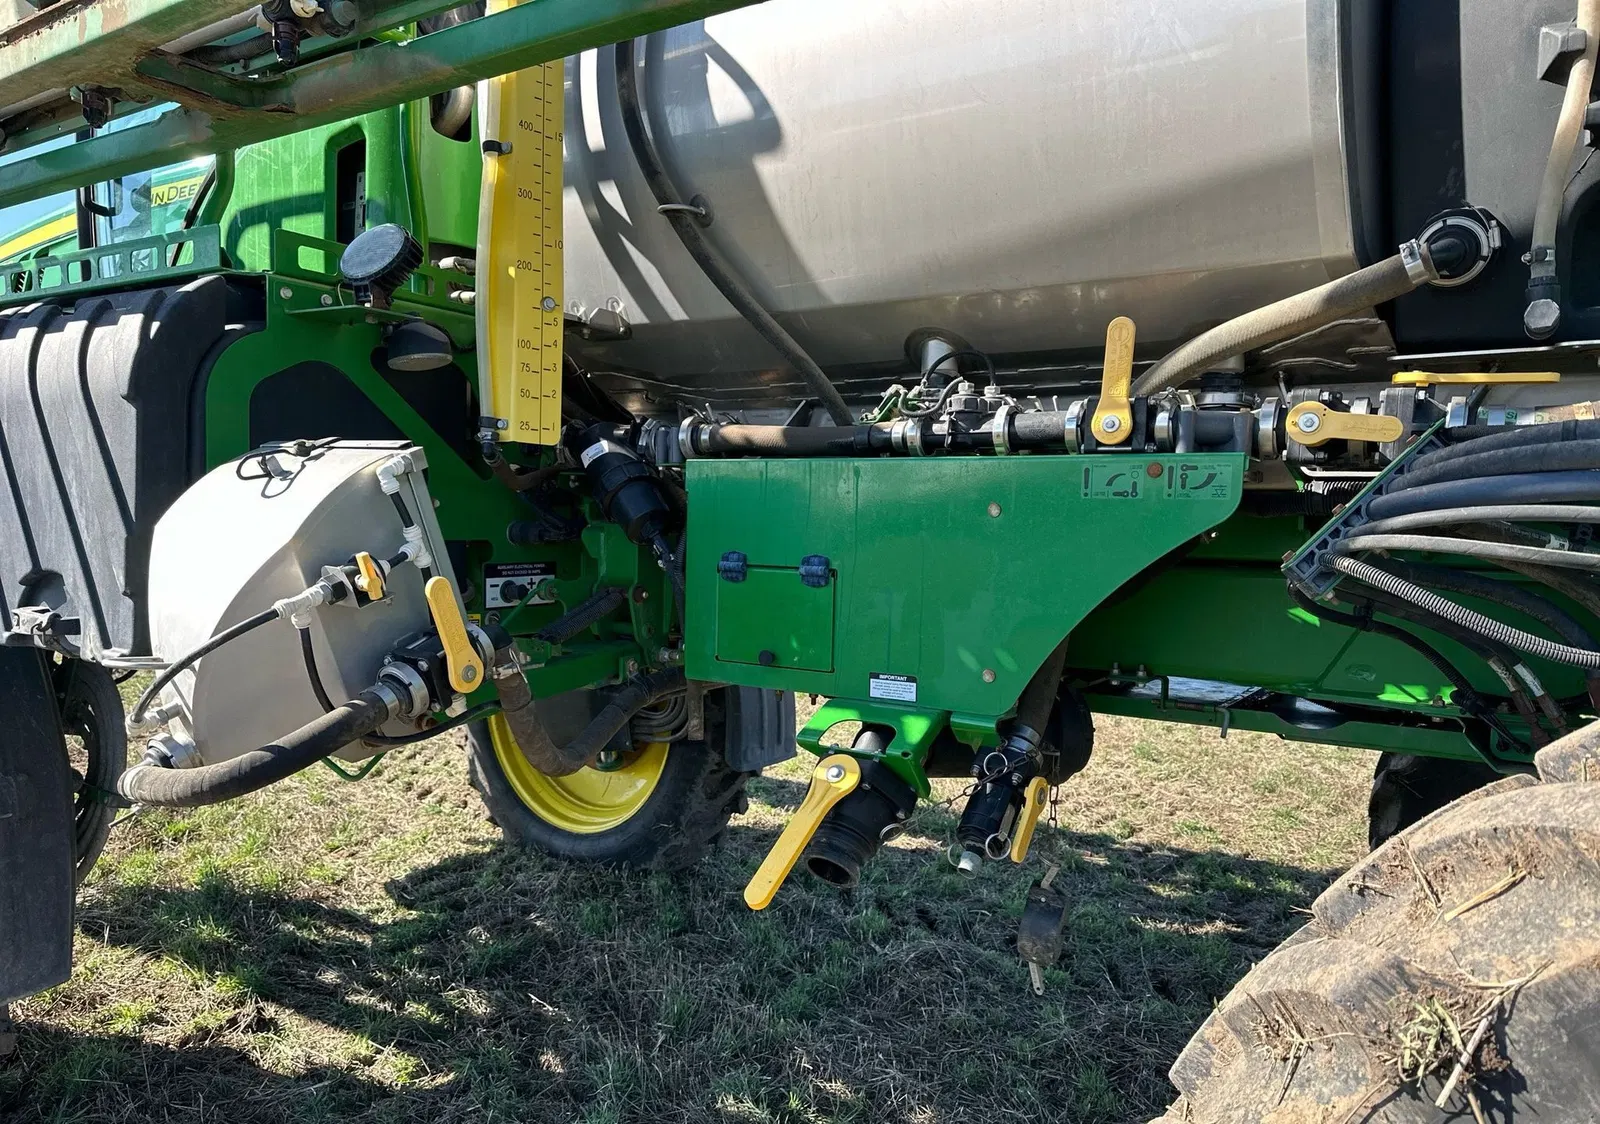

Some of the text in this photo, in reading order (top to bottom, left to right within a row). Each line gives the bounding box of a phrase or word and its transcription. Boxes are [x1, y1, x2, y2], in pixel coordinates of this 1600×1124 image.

[518, 119, 533, 132] 400
[555, 131, 563, 143] 15
[167, 184, 199, 201] DEE
[517, 187, 533, 200] 300
[555, 239, 563, 250] 10
[516, 260, 532, 271] 200
[553, 318, 558, 327] 5
[517, 339, 531, 350] 100
[552, 339, 558, 348] 4
[520, 363, 531, 373] 75
[552, 362, 557, 372] 3
[520, 388, 531, 399] 50
[552, 389, 556, 398] 2
[519, 420, 530, 431] 25
